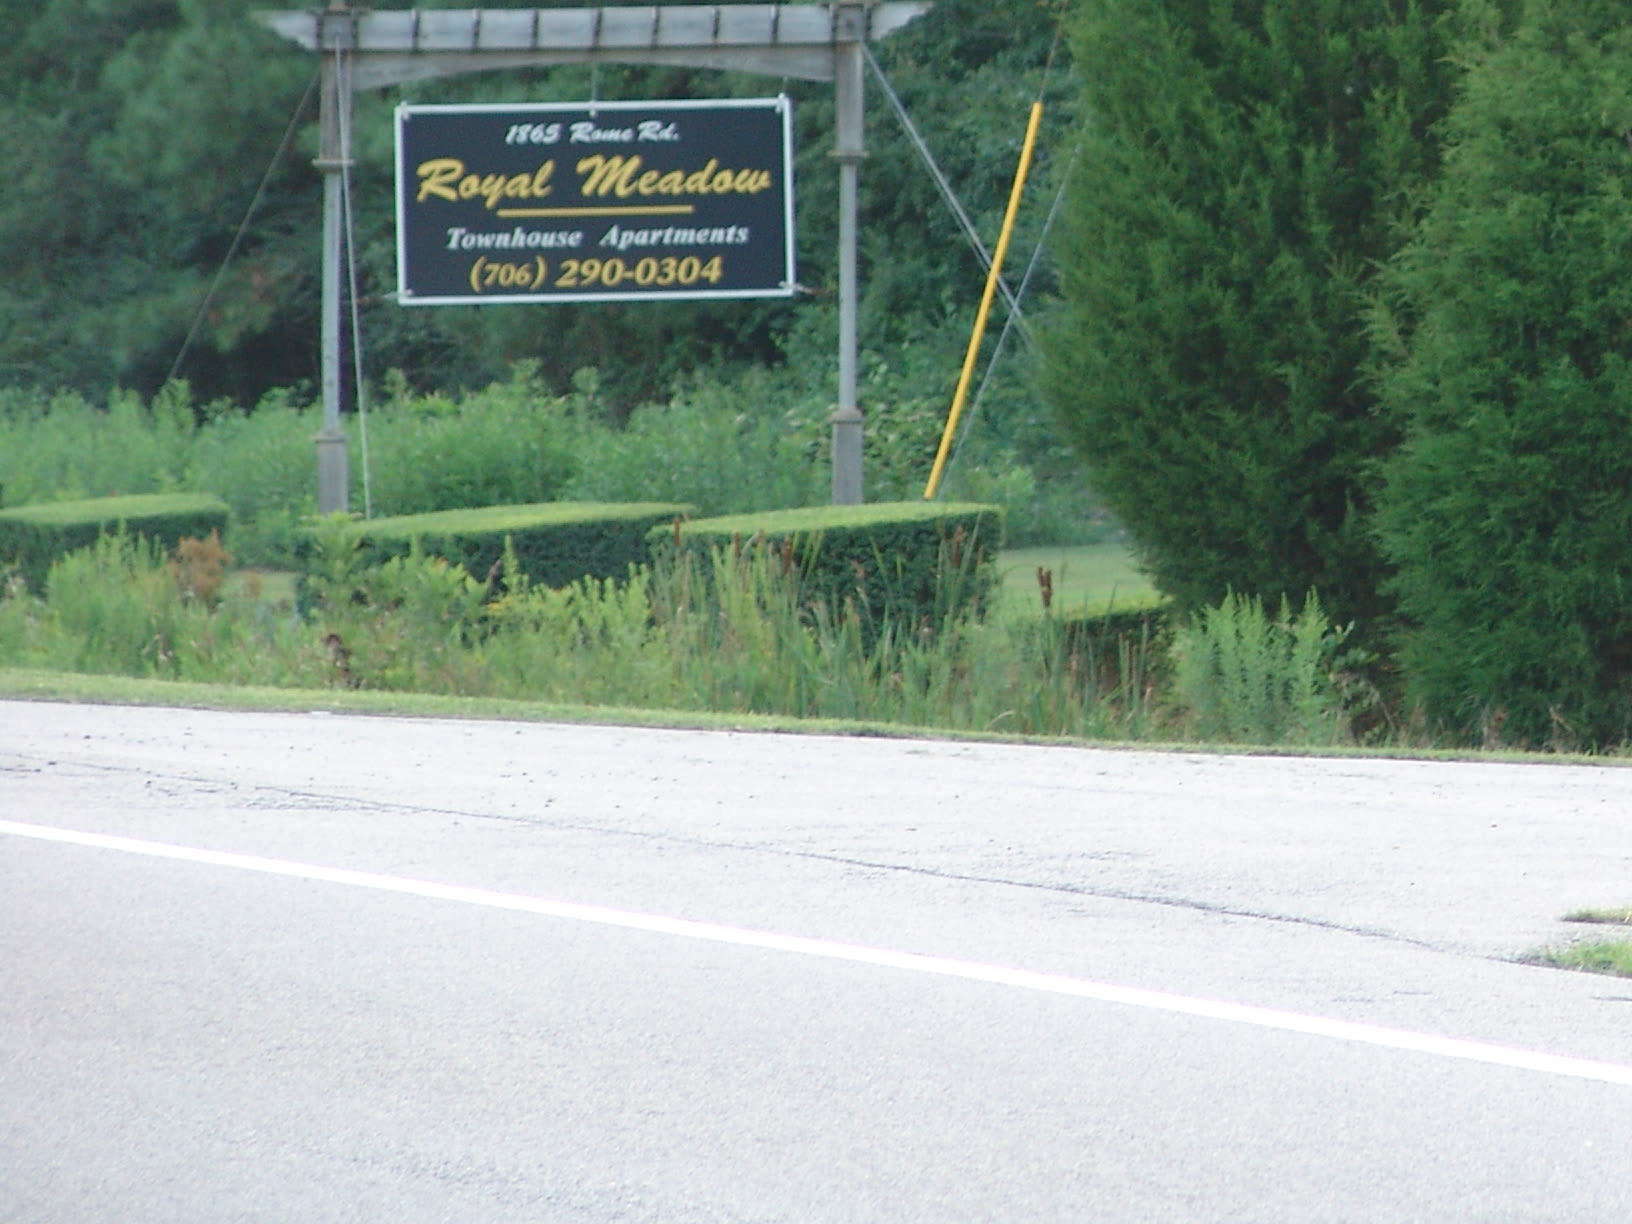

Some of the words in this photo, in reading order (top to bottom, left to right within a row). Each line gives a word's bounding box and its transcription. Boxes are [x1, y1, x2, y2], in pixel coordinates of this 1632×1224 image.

[569, 122, 633, 143] Rome
[637, 120, 680, 142] Rd.
[416, 158, 555, 209] Royal
[575, 154, 772, 199] Meadow
[446, 227, 584, 251] Townhouse
[599, 223, 749, 251] Apartments
[469, 256, 547, 293] (706)
[555, 256, 723, 288] 290-0304
